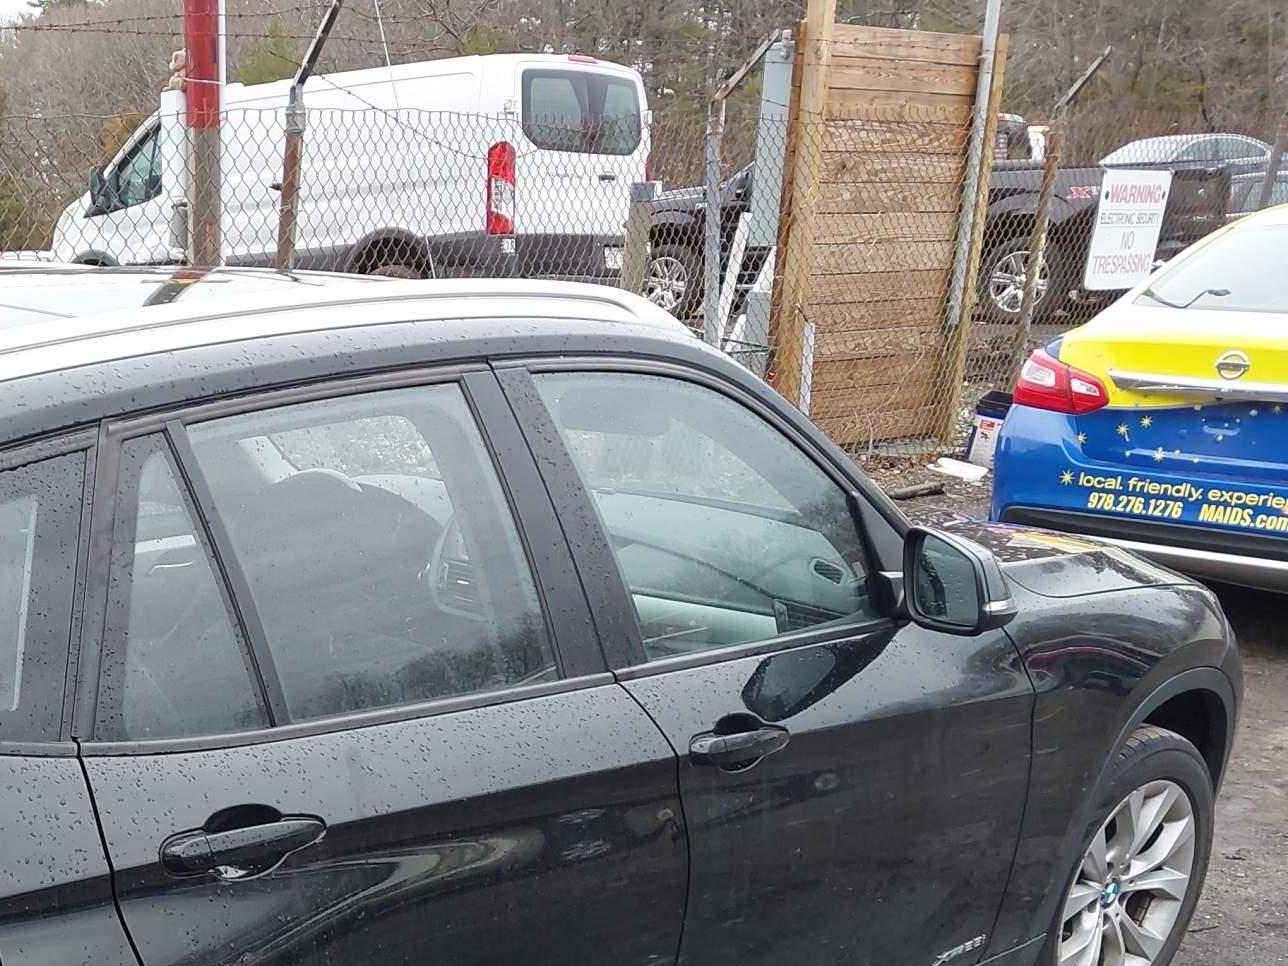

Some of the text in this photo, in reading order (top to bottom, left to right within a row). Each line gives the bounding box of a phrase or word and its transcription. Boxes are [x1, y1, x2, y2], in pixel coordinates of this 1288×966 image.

[1110, 183, 1162, 204] WARNING
[1100, 212, 1160, 225] ELECTRONIC SECURITY
[1120, 230, 1135, 250] NO
[1092, 253, 1152, 275] TRESPASSING
[1078, 471, 1288, 509] local. friendly. experie
[1087, 492, 1288, 532] 978.276.1276 MAIDS.com
